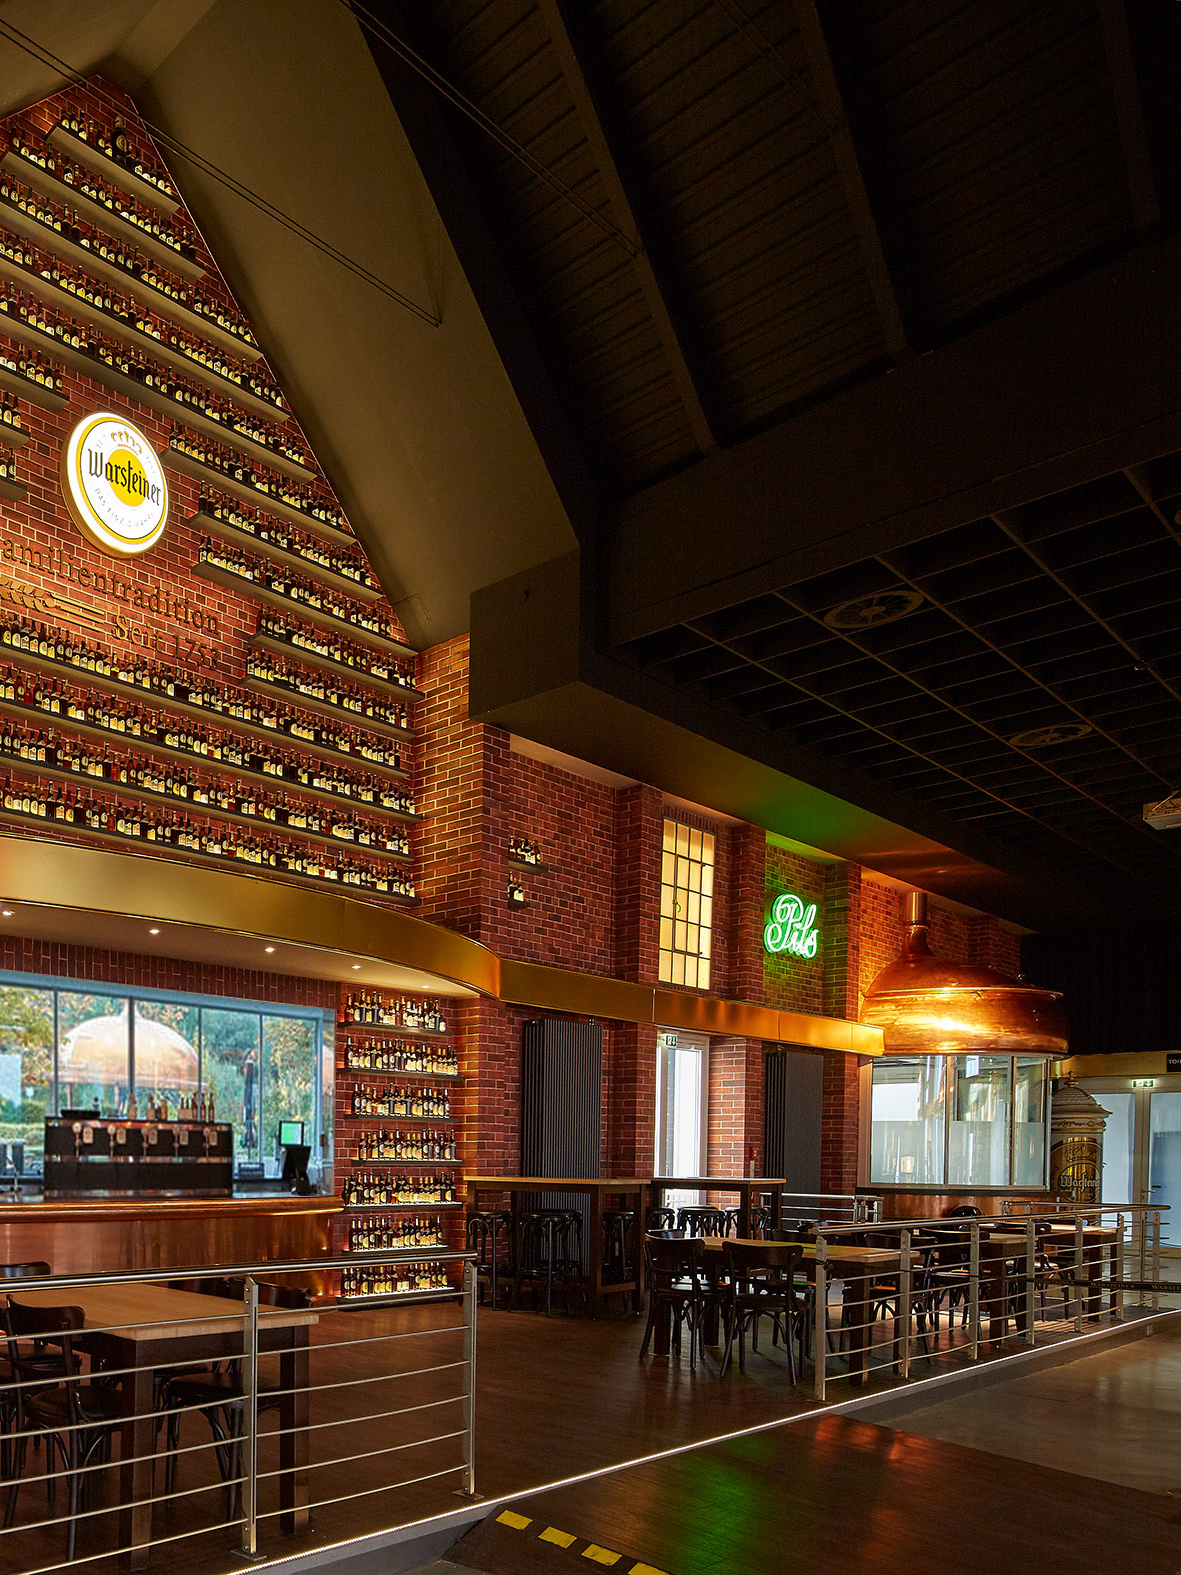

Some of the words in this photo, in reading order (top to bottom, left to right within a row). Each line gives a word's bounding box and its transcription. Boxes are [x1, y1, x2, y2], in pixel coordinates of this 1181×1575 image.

[87, 448, 162, 507] Warsteiner
[114, 613, 162, 650] Seit
[174, 634, 219, 669] 1753
[765, 893, 819, 959] Pils
